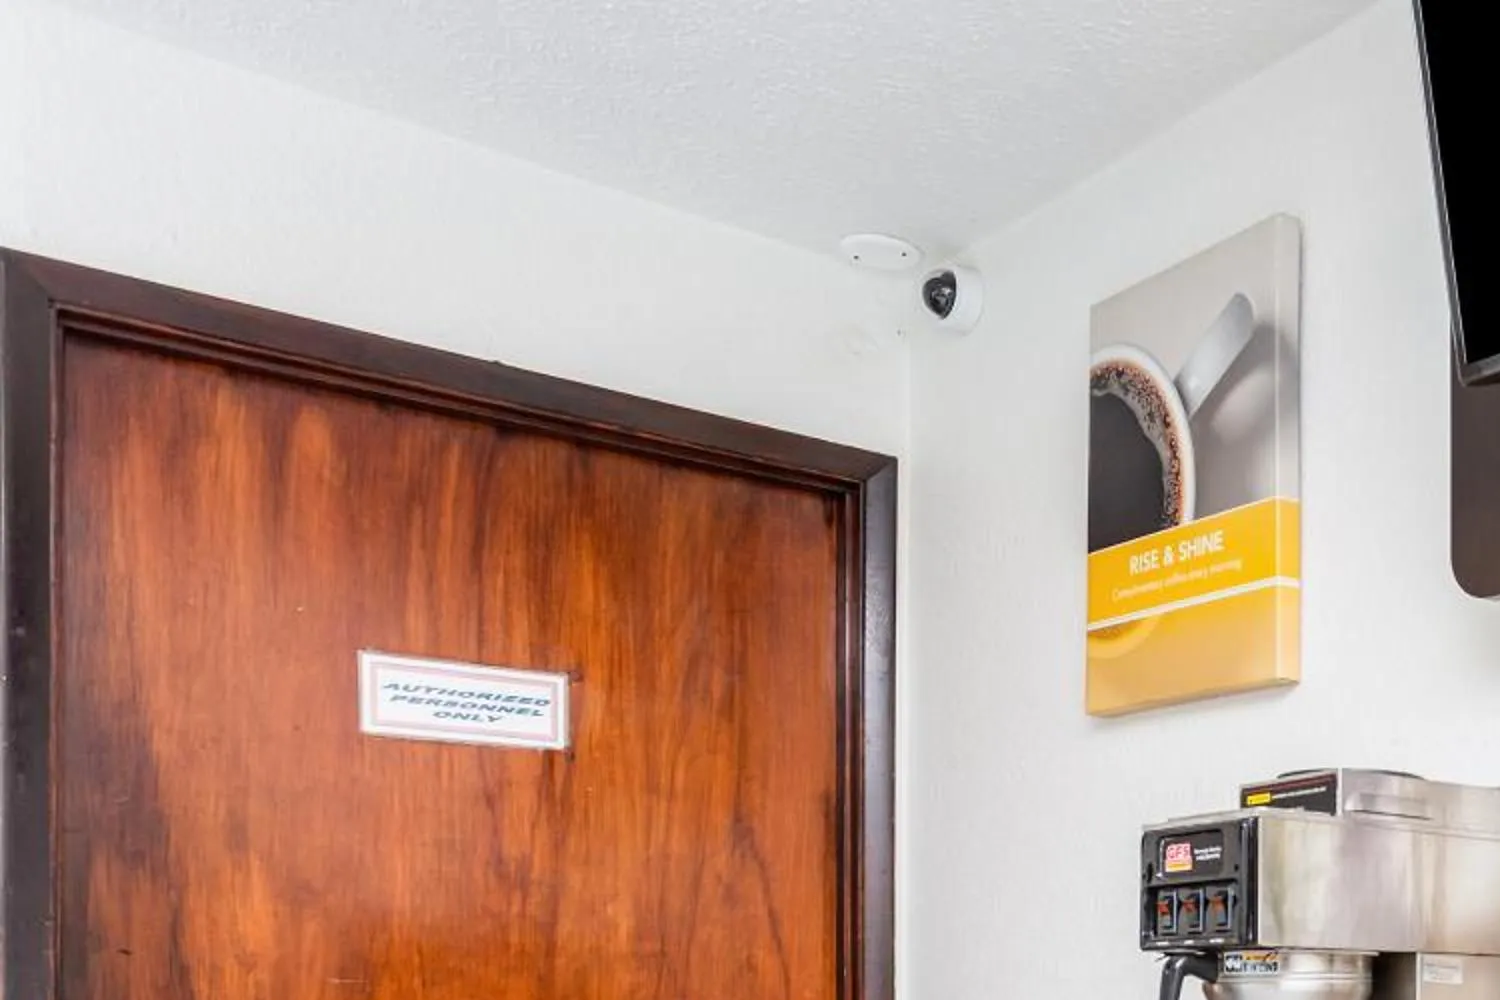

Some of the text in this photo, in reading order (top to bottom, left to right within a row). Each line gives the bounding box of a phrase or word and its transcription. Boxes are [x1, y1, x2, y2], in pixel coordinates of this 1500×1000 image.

[1128, 530, 1226, 577] RISE & SHINE
[383, 682, 551, 707] AUTHORIZED
[390, 694, 545, 717] PERSONNEL
[433, 711, 504, 723] ONLY
